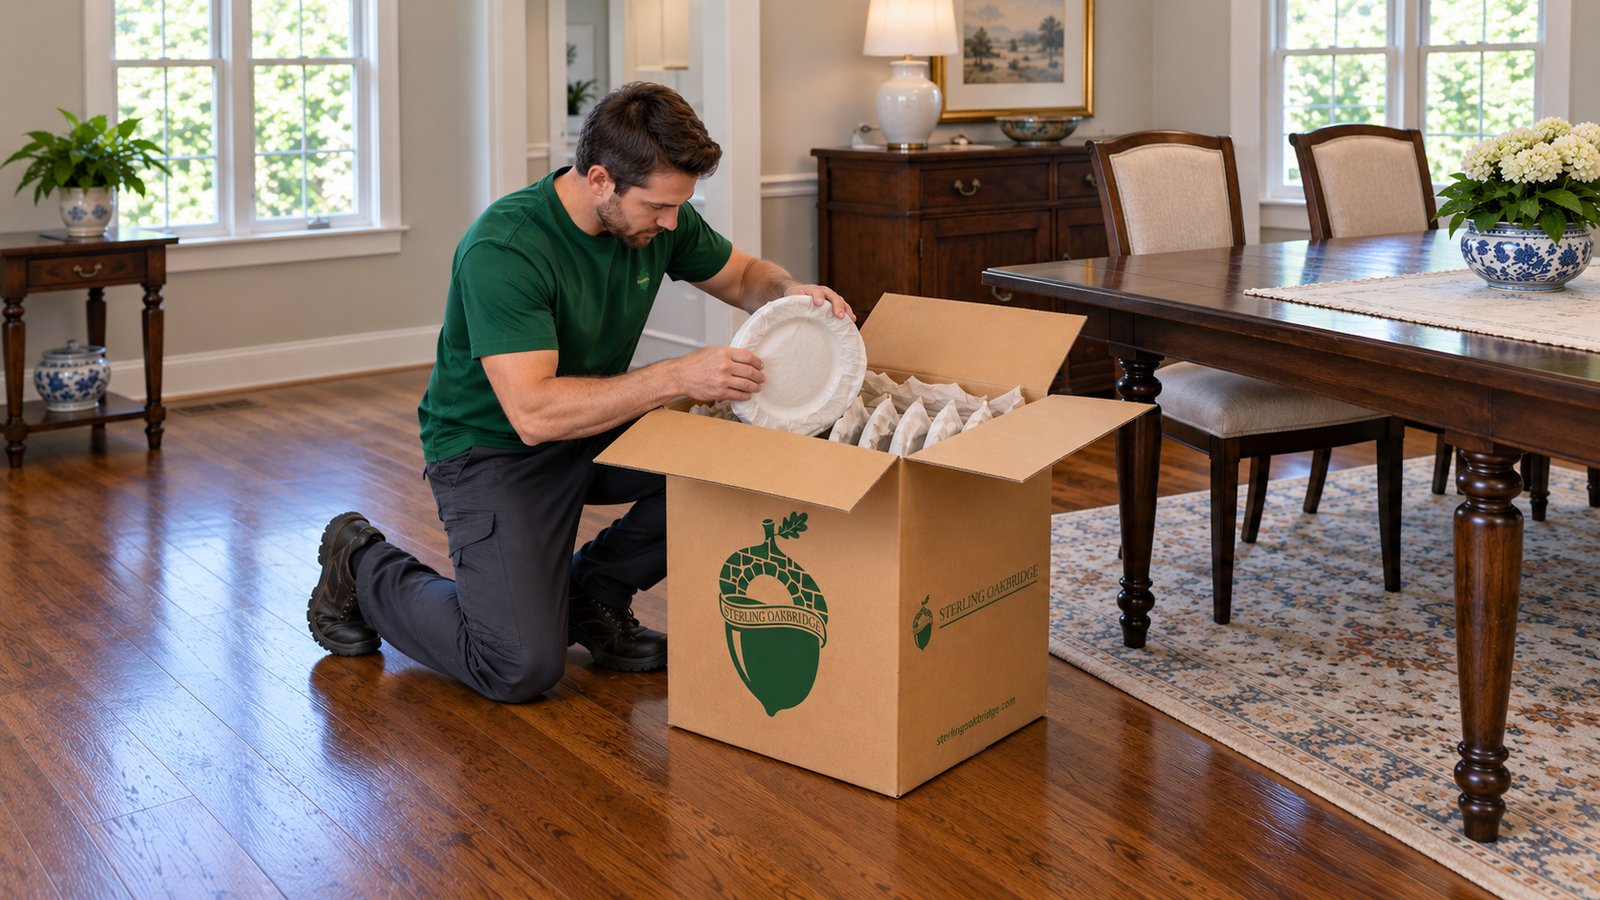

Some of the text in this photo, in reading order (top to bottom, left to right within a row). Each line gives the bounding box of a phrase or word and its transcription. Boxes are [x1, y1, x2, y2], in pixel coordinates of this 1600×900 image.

[939, 564, 1038, 621] STERLING OAKBRIDGE
[723, 605, 821, 633] STERLING OAKBRIDGE
[936, 697, 1016, 745] sterlingoakbridge.com
